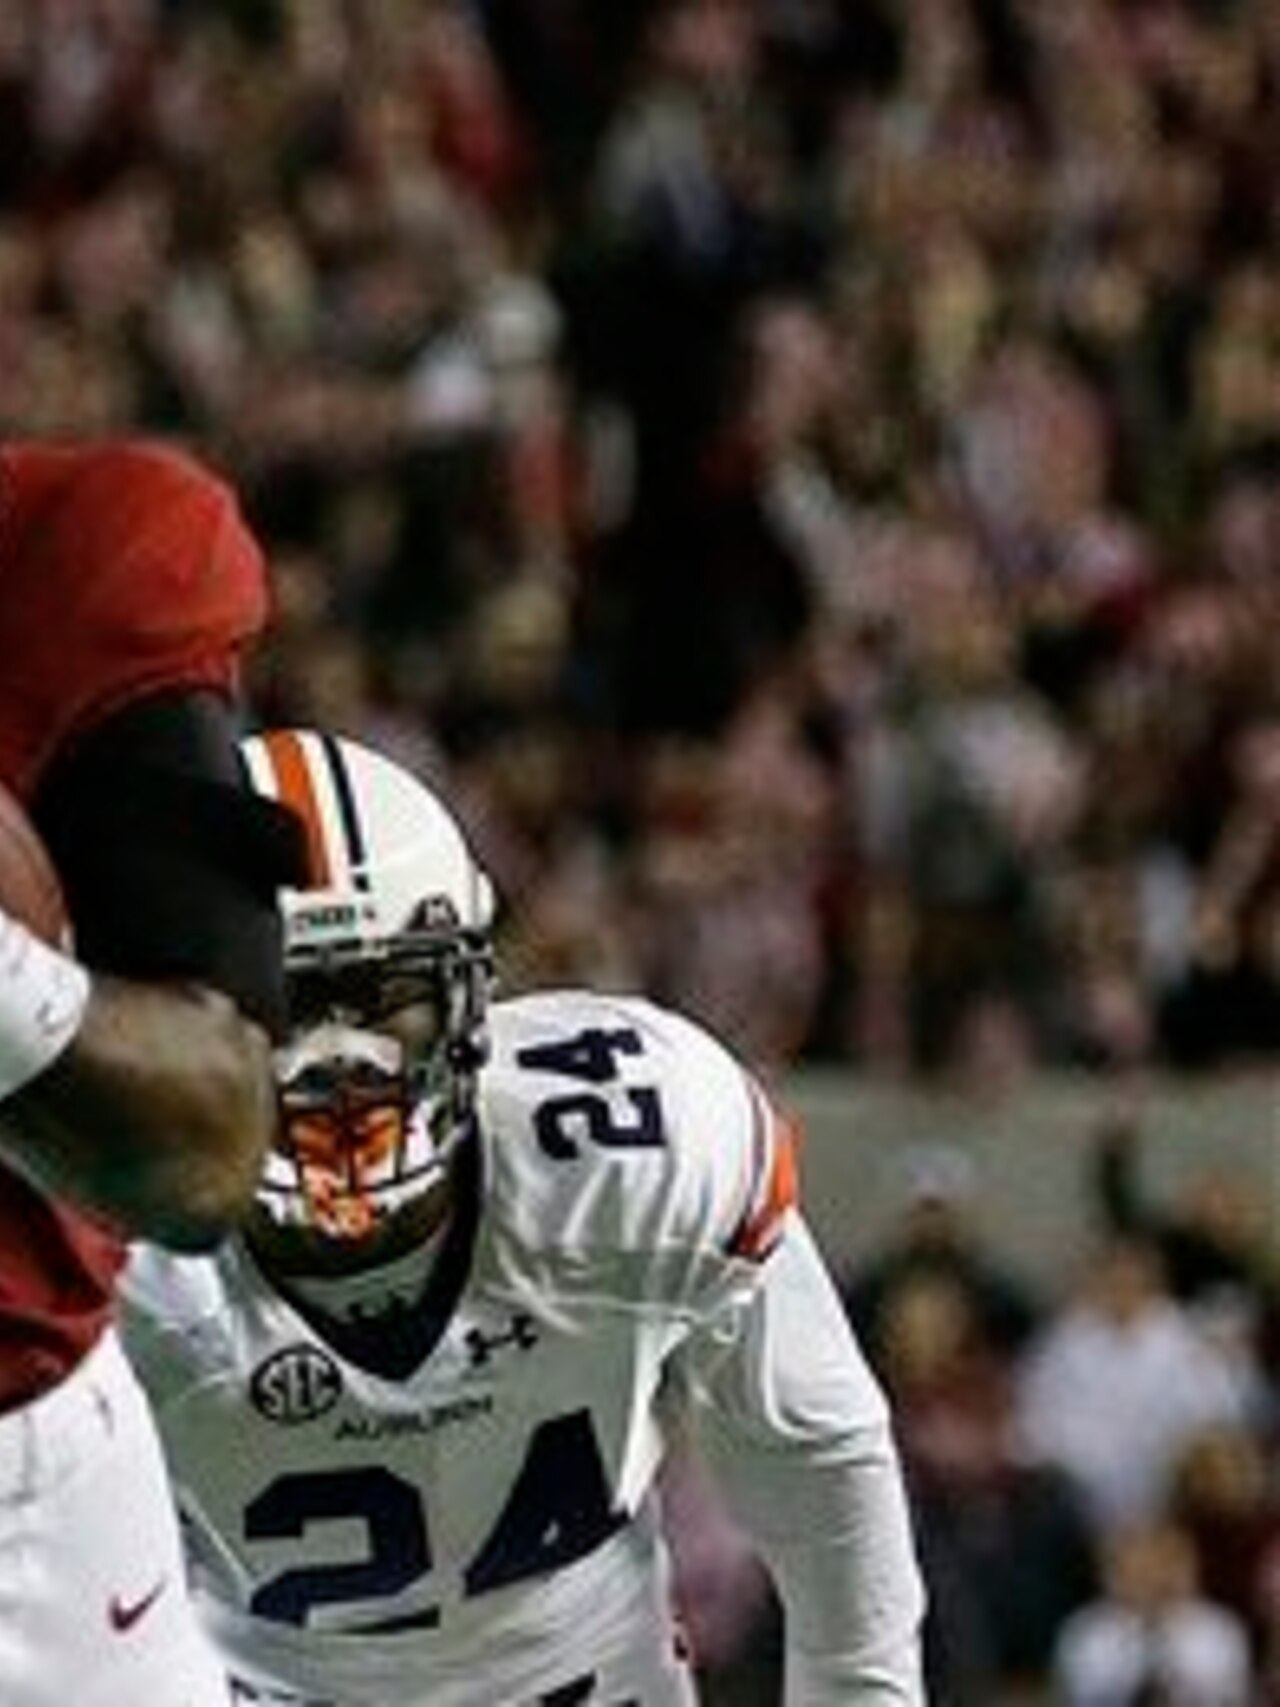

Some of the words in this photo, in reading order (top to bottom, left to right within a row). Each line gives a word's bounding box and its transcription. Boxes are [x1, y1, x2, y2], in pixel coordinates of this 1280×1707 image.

[517, 1029, 667, 1161] 24
[250, 1341, 342, 1424] SEC
[243, 1406, 632, 1636] 24
